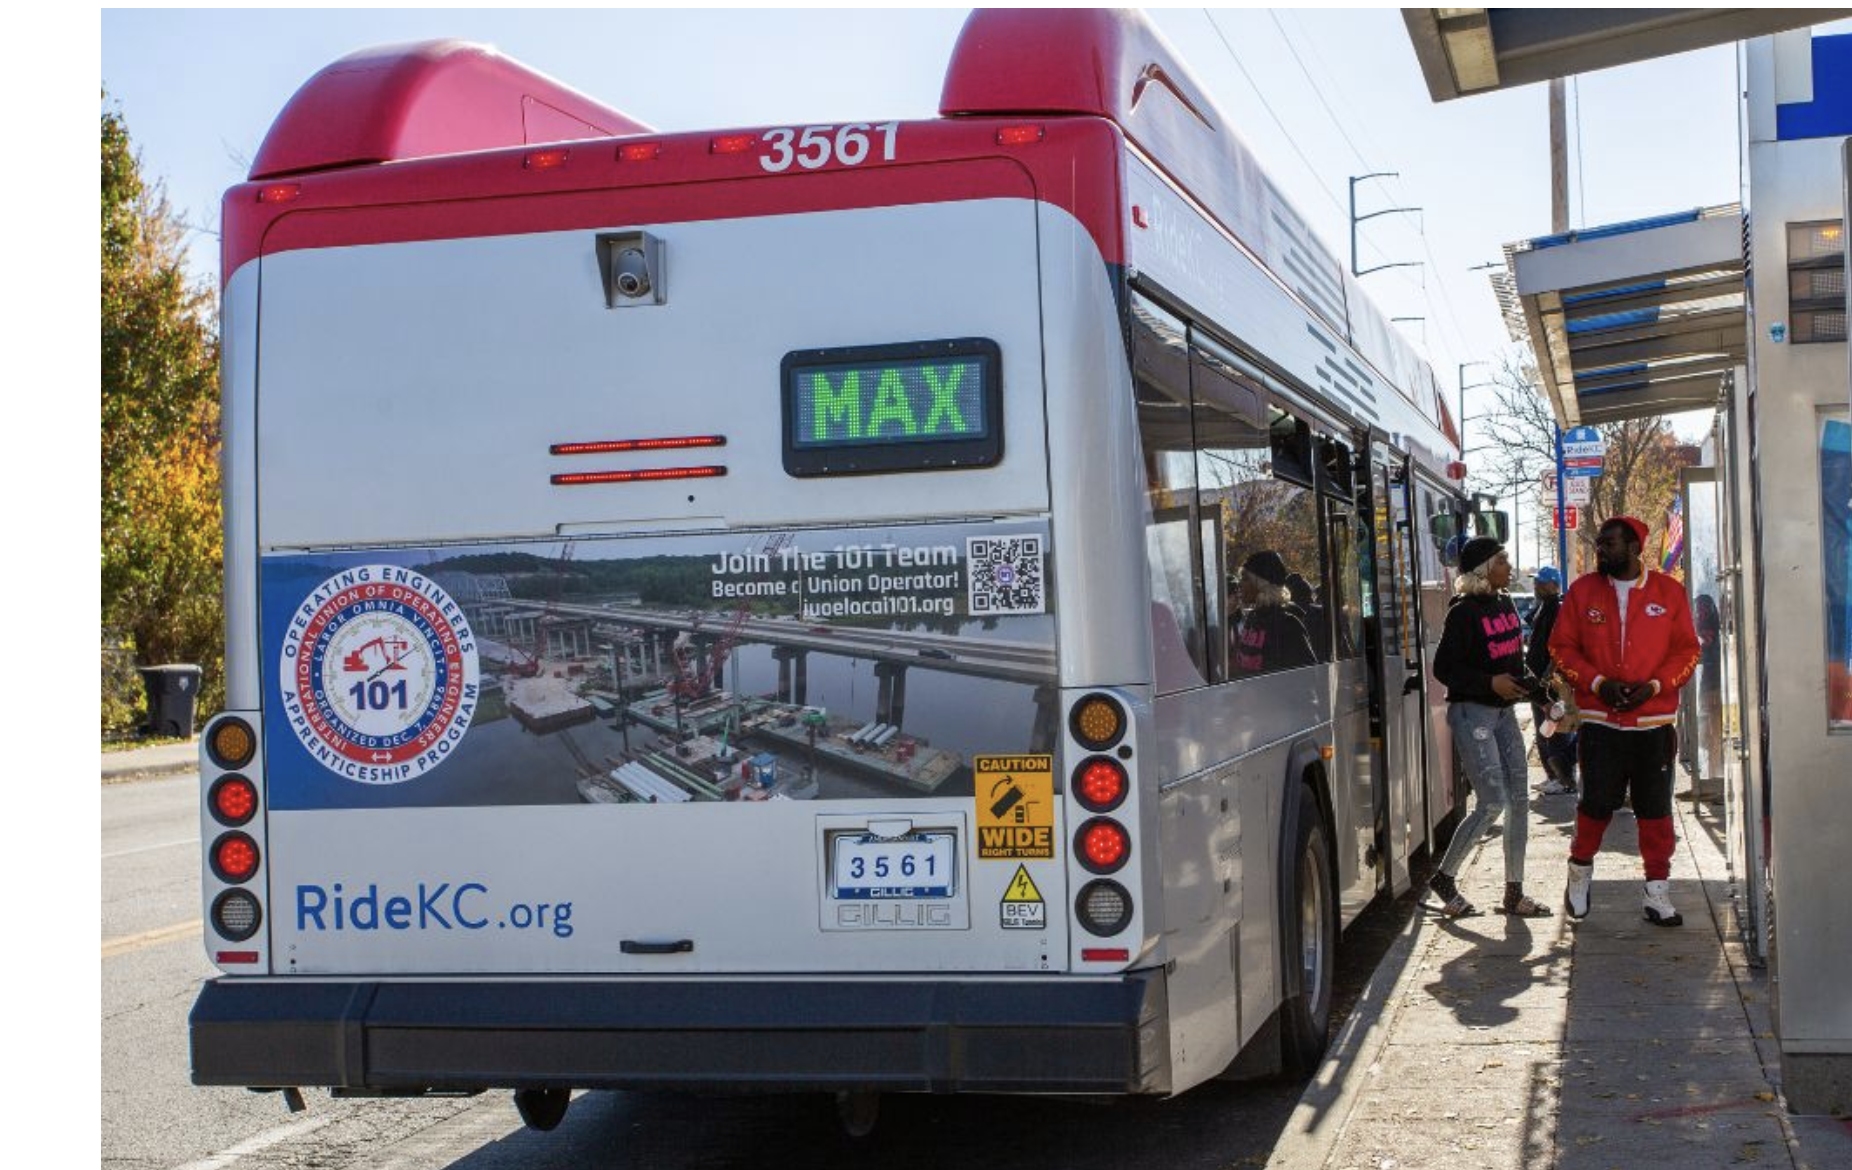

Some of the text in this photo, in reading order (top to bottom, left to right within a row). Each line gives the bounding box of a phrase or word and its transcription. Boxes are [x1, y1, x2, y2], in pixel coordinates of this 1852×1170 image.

[759, 121, 899, 172] 3561
[813, 363, 966, 439] MAX
[712, 543, 957, 574] Join The 101 Team
[712, 580, 786, 597] Become
[808, 574, 861, 593] Union
[868, 571, 959, 593] Operator!
[285, 568, 474, 657] OPERATING ENGINEERS
[315, 601, 445, 664] LABOR OMNIA VINCIT
[299, 586, 460, 751] INTERNATIONAL UNION OF OPERATING ENGINEERS
[350, 680, 408, 710] 101
[284, 683, 477, 781] APPRENTICESHIP PROGRAM
[315, 690, 376, 747] ORGANIZED
[980, 757, 1048, 771] CAUTION
[981, 827, 1049, 847] WIDE
[981, 848, 1049, 856] RIGHT TURNS
[850, 854, 935, 878] 3561
[870, 887, 913, 897] GILLIG
[296, 883, 573, 938] RideKC.org
[838, 904, 951, 927] GILLIG
[1006, 904, 1038, 916] BEV
